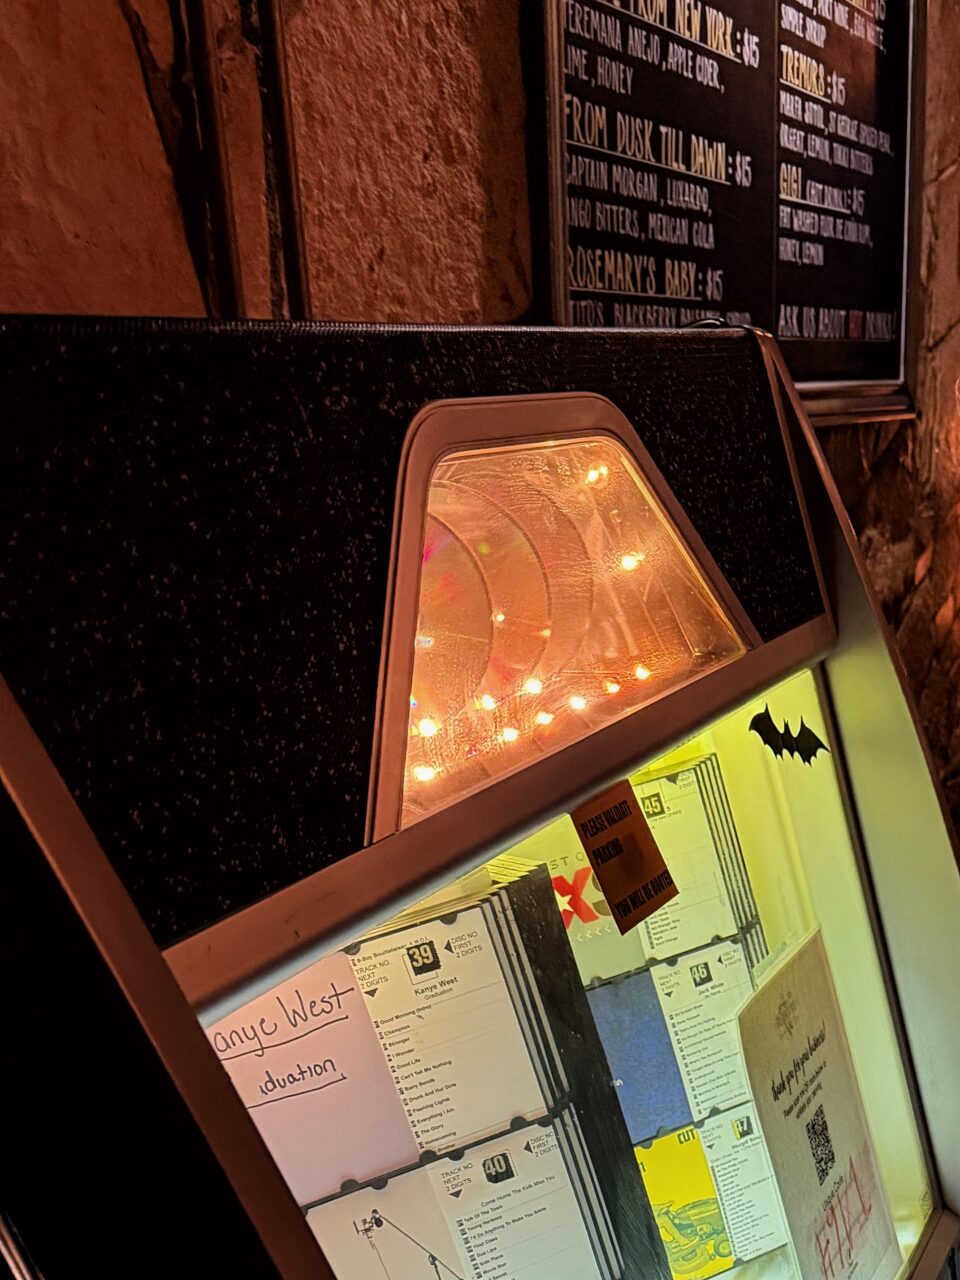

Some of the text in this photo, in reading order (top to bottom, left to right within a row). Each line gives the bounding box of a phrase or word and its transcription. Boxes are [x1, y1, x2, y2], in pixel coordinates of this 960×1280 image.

[676, 0, 700, 41] NEW
[668, 42, 693, 78] APPLE
[598, 57, 633, 95] HONEY
[565, 94, 608, 149] FROM
[617, 112, 655, 163] DUSK
[660, 125, 686, 170] TILL
[649, 212, 688, 246] MEXICAN
[693, 221, 715, 249] COLA
[568, 244, 656, 296] ROSEMARY'S
[778, 304, 800, 336] ASK
[803, 306, 815, 338] US
[642, 796, 661, 816] 45
[614, 896, 632, 920] YOU
[450, 934, 467, 944] DISC
[452, 940, 472, 951] FIRST
[407, 943, 434, 969] 39
[460, 944, 483, 956] DIGITS
[355, 962, 378, 975] TRACK
[357, 971, 376, 982] NEXT
[690, 963, 708, 982] 46
[365, 975, 388, 987] DIGITS
[413, 975, 458, 997] Kanye West
[277, 982, 354, 1028] West
[379, 1016, 394, 1025] Good
[393, 1008, 416, 1021] Morning
[395, 1057, 421, 1070] Good Life
[532, 1140, 549, 1150] FIRST
[440, 1166, 462, 1179] TRACK
[482, 1154, 508, 1177] 40
[443, 1174, 460, 1184] NEXT
[450, 1177, 472, 1189] DIGITS
